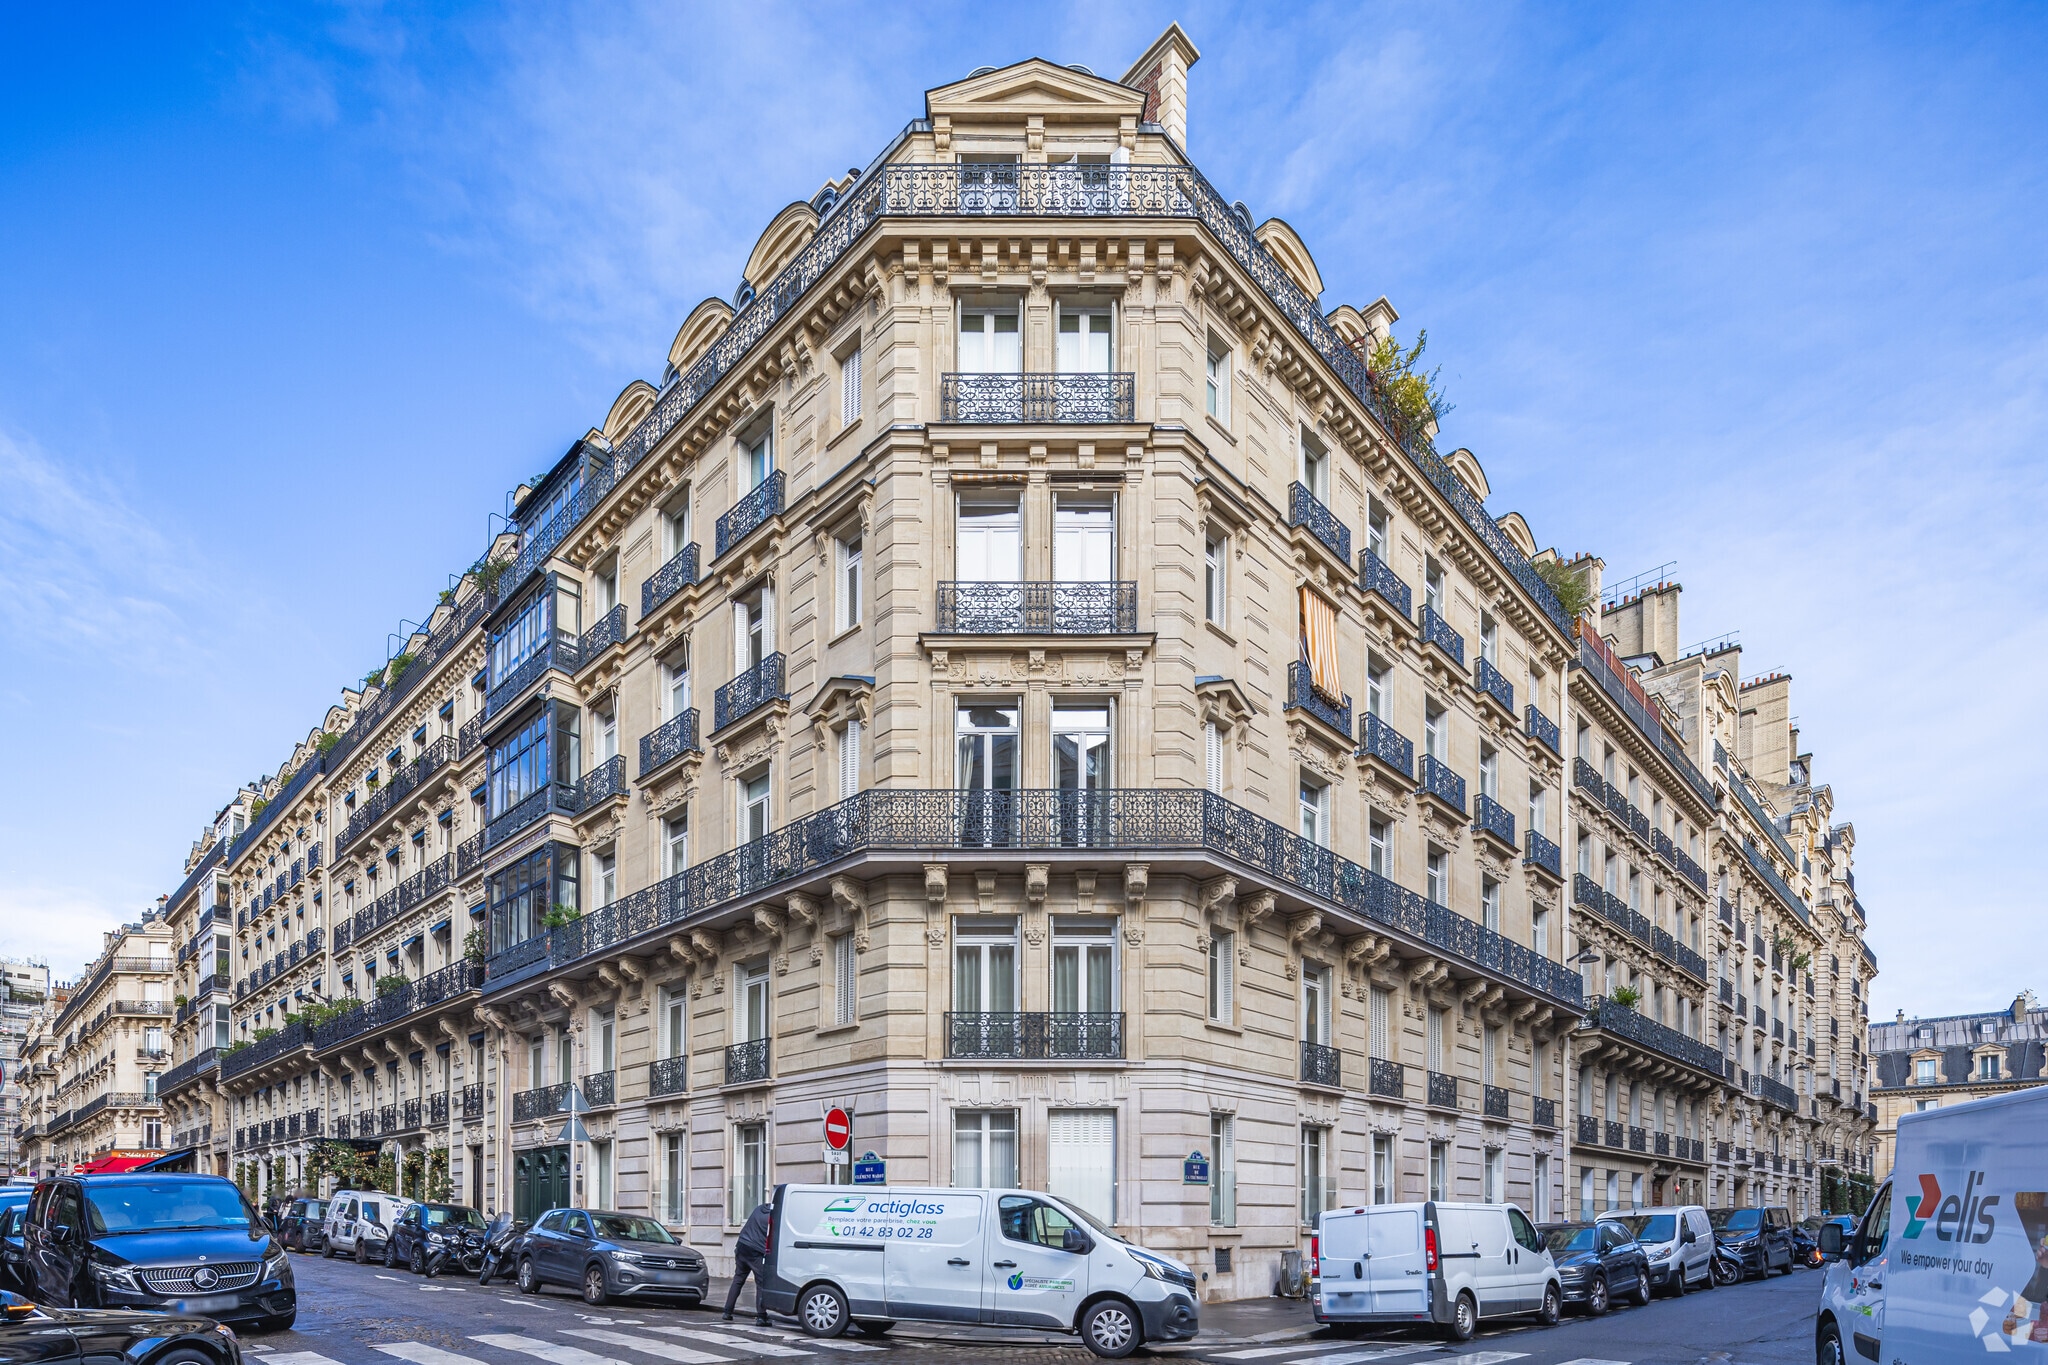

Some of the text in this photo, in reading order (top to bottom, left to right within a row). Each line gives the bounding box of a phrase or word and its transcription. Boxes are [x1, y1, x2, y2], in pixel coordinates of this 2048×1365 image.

[868, 1199, 945, 1218] actiglass
[1936, 1170, 2000, 1244] elis
[842, 1226, 933, 1239] 01 42 83 02 28
[1901, 1250, 1994, 1279] We empower your day
